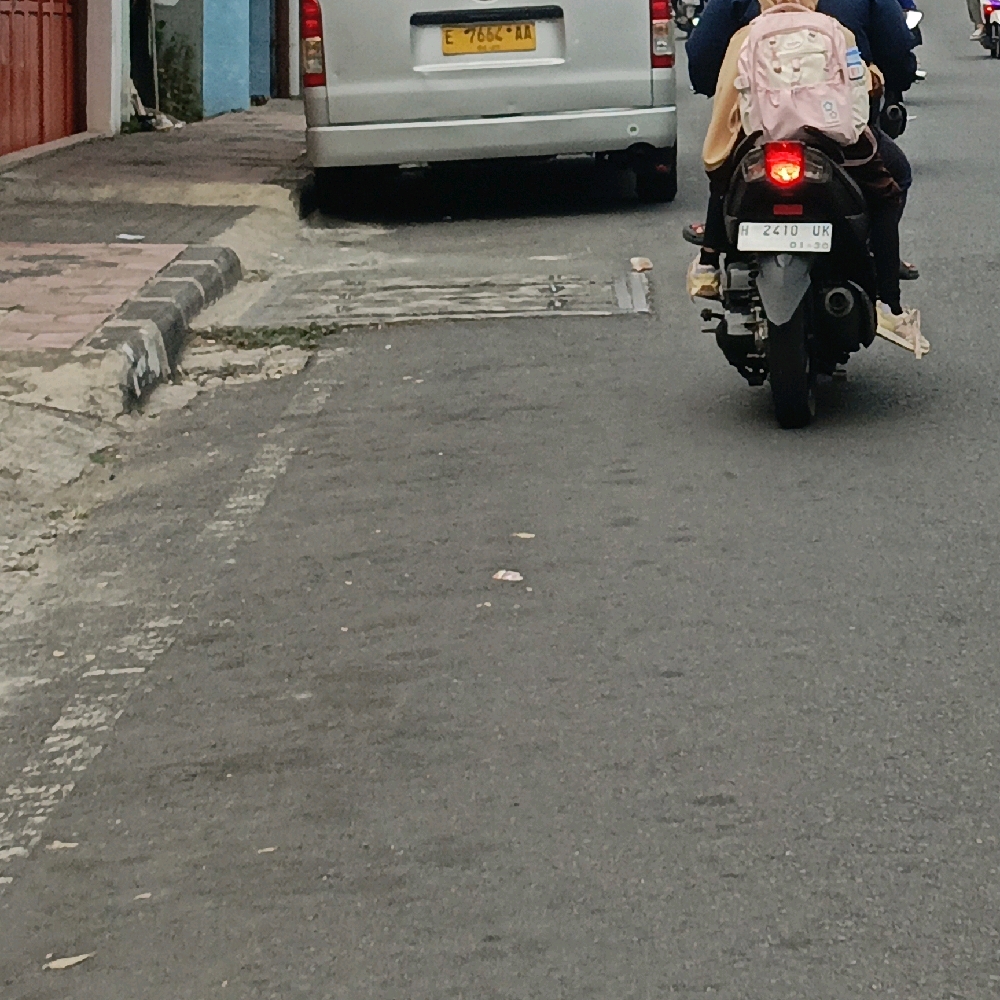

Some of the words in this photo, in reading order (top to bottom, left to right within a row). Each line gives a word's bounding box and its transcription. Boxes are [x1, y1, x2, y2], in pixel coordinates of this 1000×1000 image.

[445, 29, 454, 45] E
[515, 25, 532, 41] AA
[740, 225, 749, 237] H
[762, 224, 799, 237] 2410
[812, 225, 830, 237] UK
